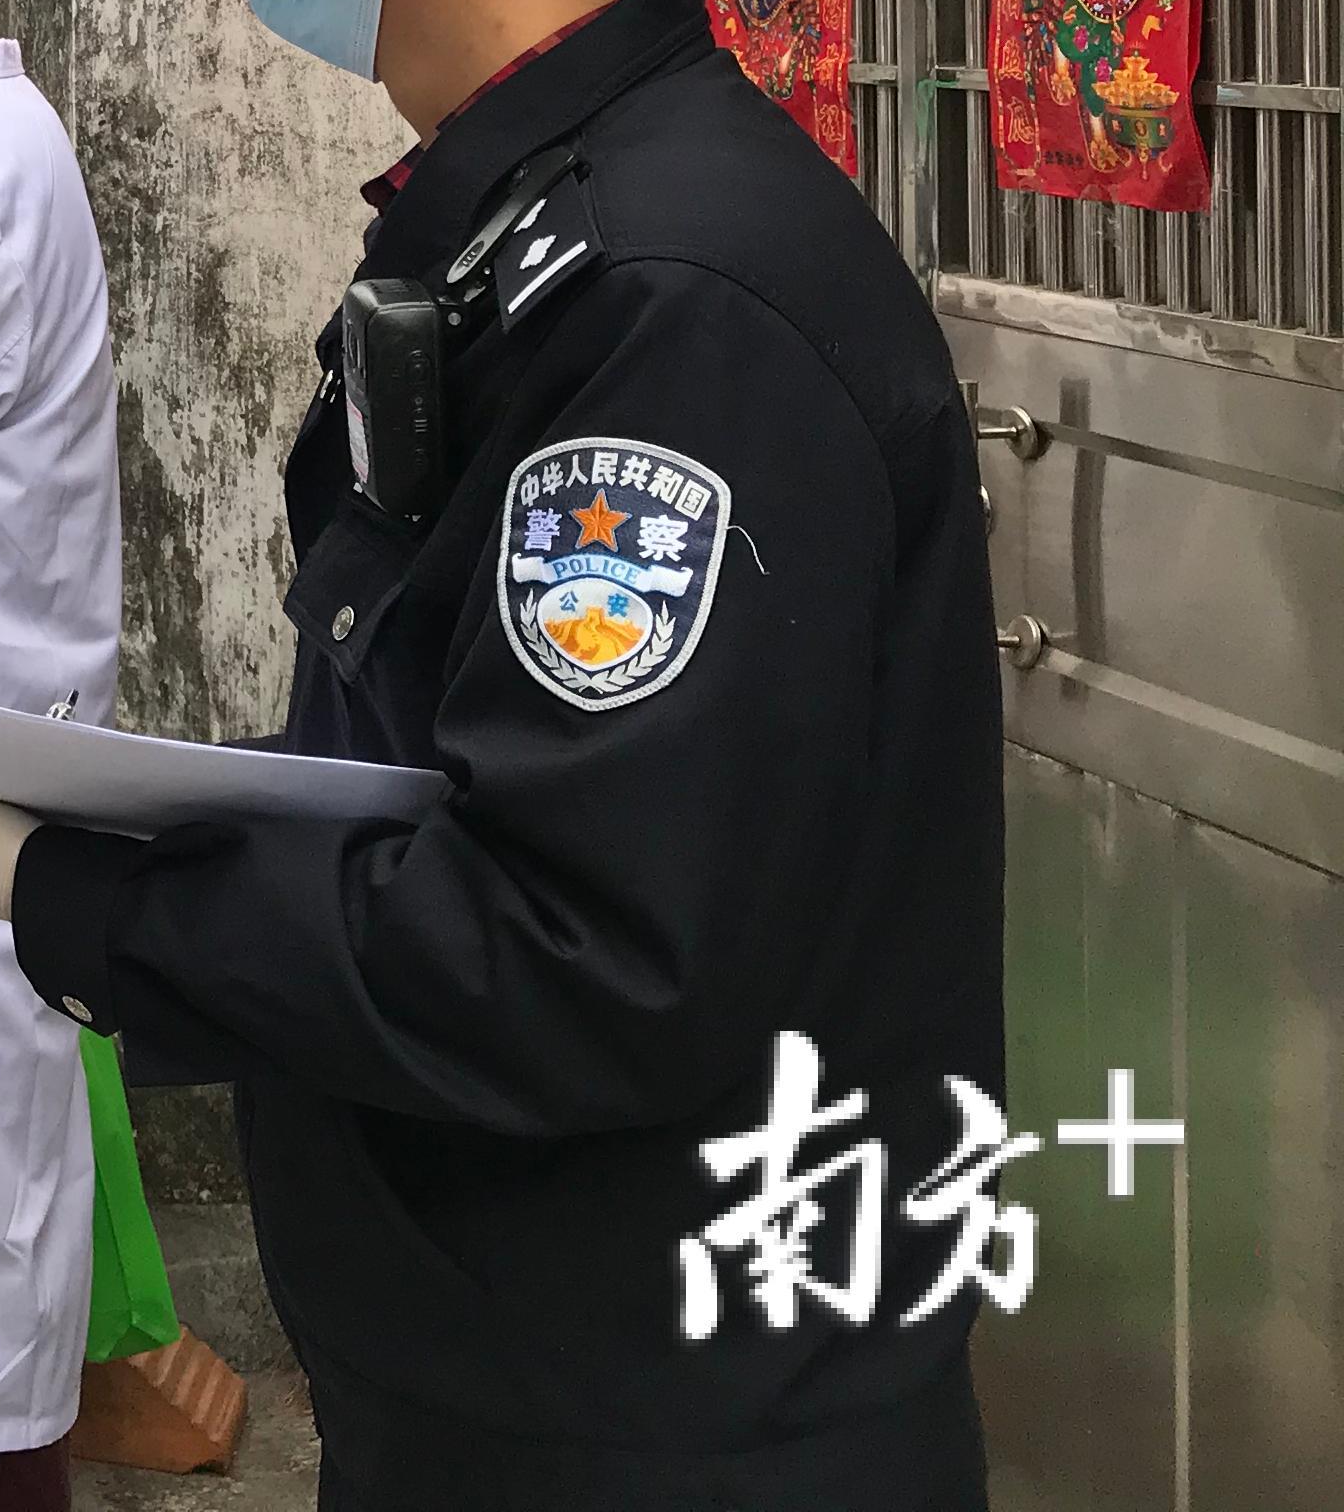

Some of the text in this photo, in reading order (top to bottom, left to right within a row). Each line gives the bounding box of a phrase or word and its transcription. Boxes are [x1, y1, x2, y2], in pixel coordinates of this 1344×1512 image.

[520, 451, 712, 521] 中华人民共和国
[554, 558, 641, 585] POLICE
